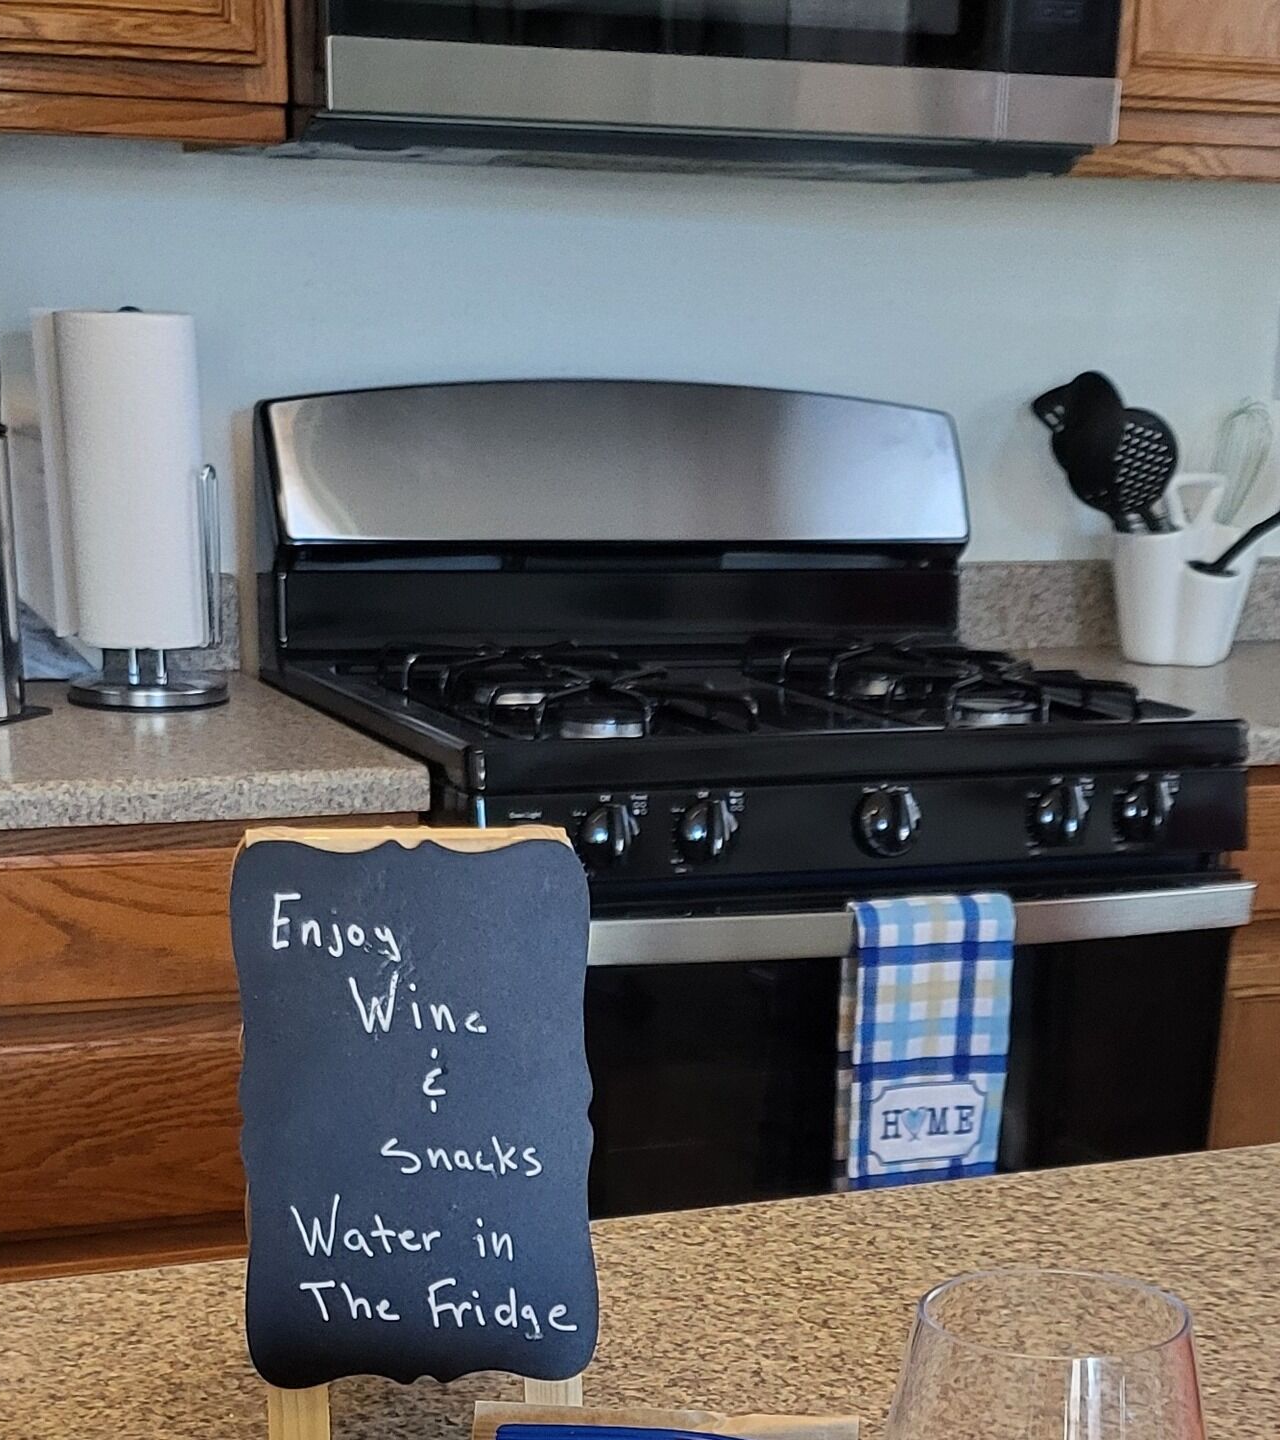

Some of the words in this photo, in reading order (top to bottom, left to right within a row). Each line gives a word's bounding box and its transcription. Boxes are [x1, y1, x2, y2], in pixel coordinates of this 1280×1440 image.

[273, 892, 402, 962] Enjoy
[348, 971, 489, 1033] Wine
[381, 1137, 544, 1177] Snacks
[290, 1194, 442, 1258] Water
[477, 1217, 515, 1261] in
[300, 1280, 400, 1322] The
[427, 1277, 578, 1339] Fridge
